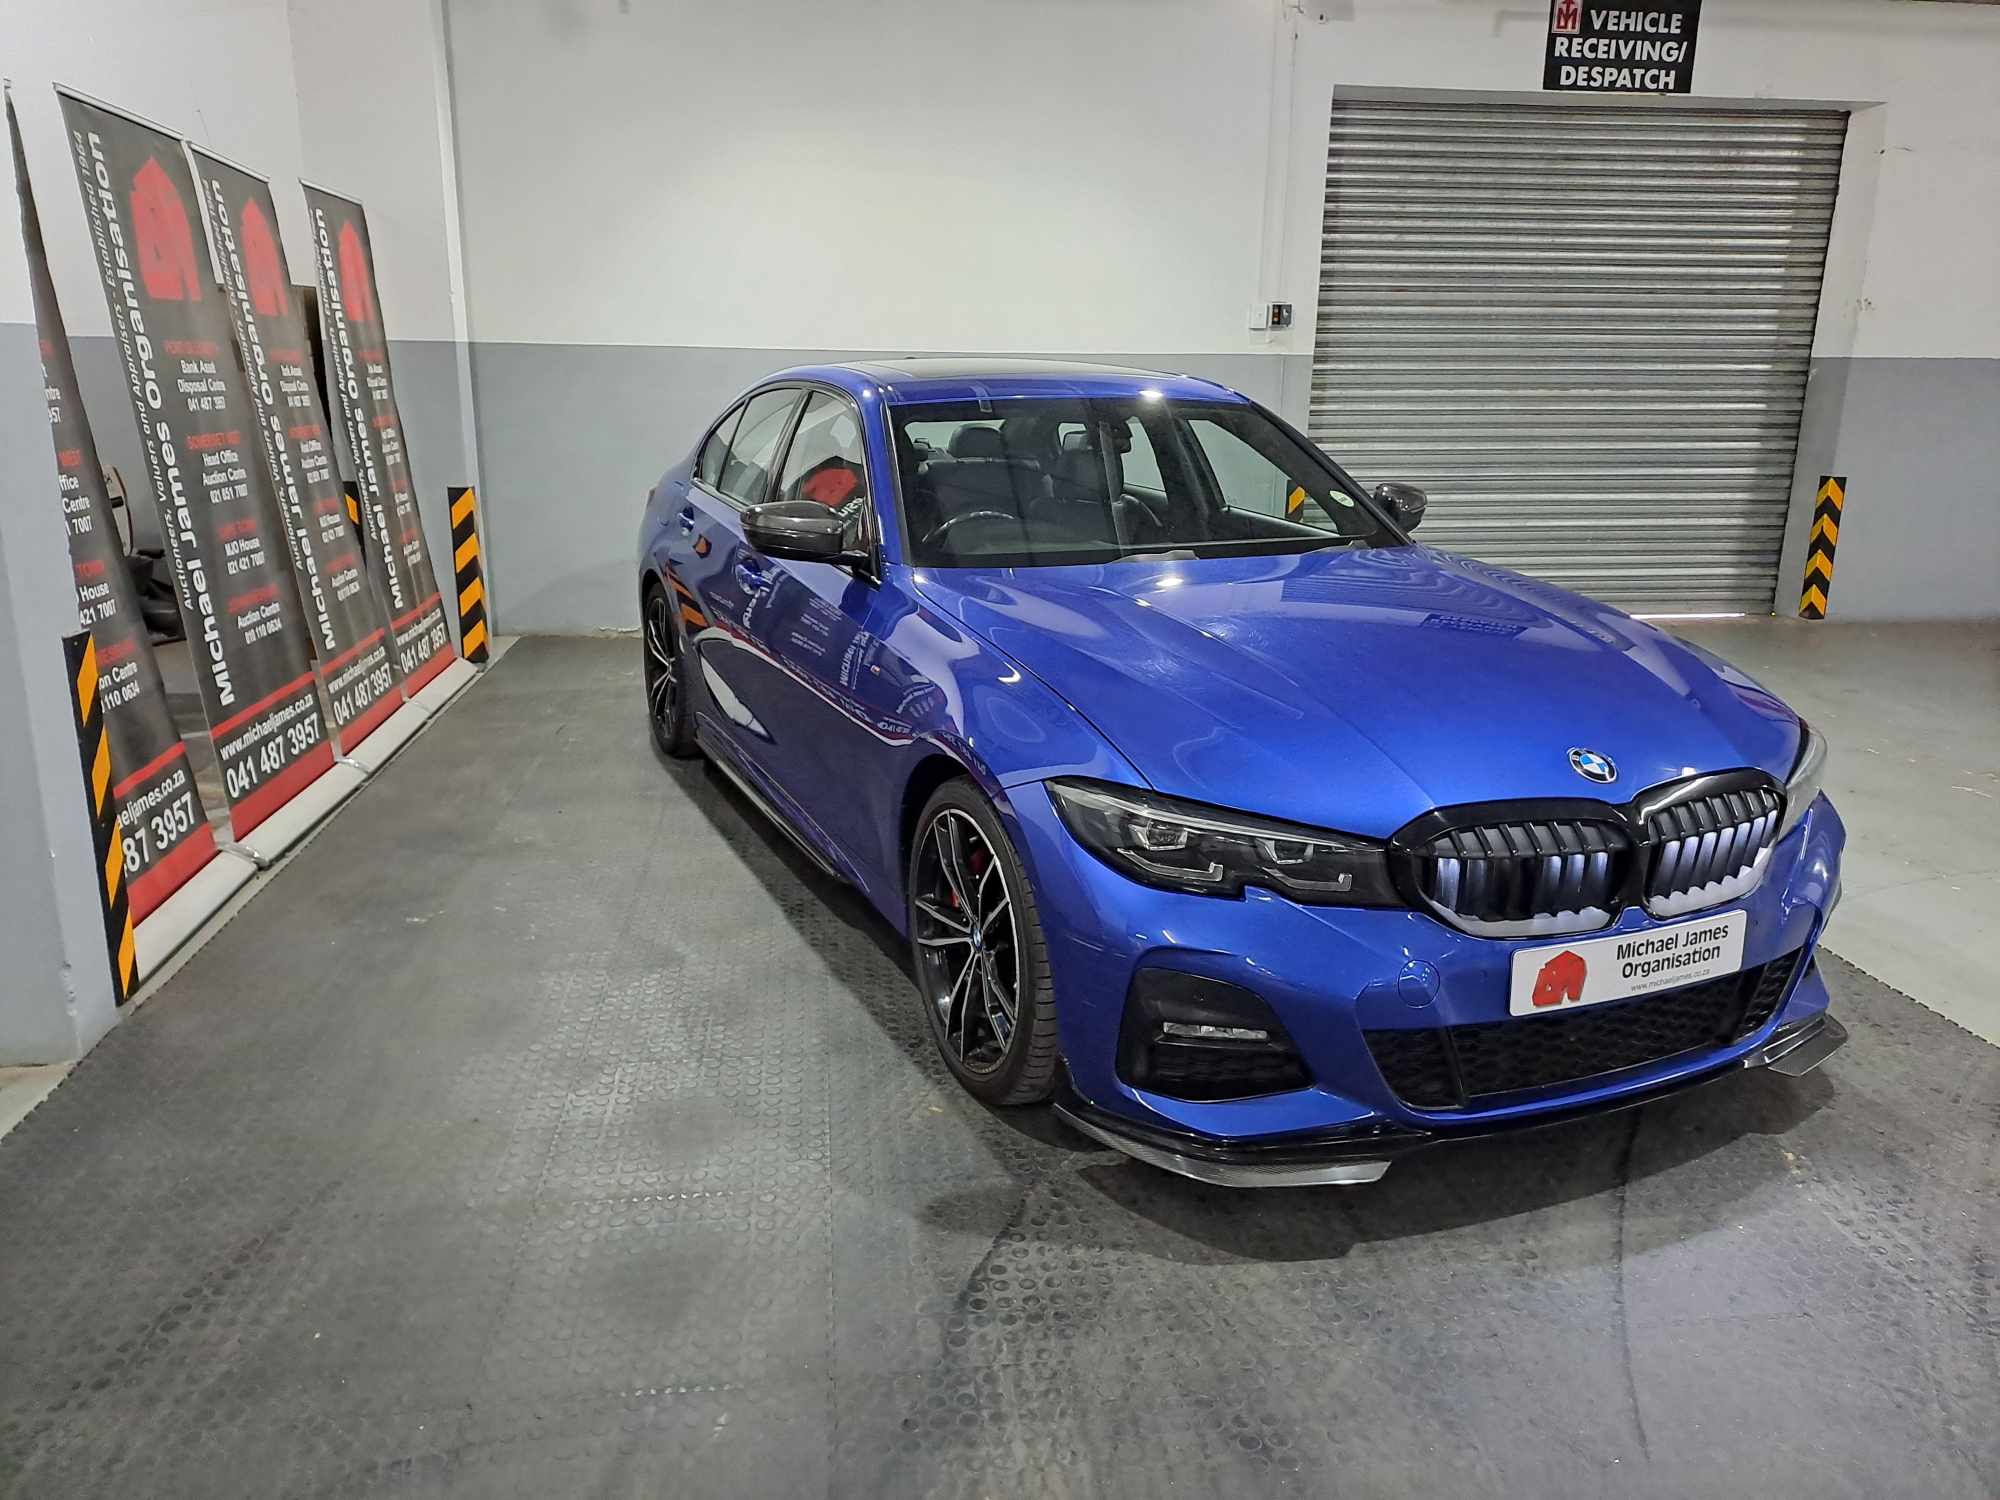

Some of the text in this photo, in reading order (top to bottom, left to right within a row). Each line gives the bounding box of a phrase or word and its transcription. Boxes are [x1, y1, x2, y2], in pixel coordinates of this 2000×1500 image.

[1554, 37, 1688, 63] RECEIVING/
[1590, 9, 1683, 34] VEHICLE
[1560, 65, 1676, 90] DESPATCH
[84, 181, 116, 287] Established
[211, 179, 273, 405] Organisation
[315, 208, 359, 400] Organisation
[113, 303, 142, 397] Appraisers
[88, 132, 235, 707] Michael James Organisation
[135, 400, 151, 434] and
[254, 397, 268, 426] and
[58, 474, 80, 491] ffice
[147, 440, 167, 501] Valuers
[270, 415, 303, 519] James
[354, 407, 380, 497] James
[62, 496, 90, 514] Centre
[164, 509, 194, 611] Auctioneers,
[373, 504, 403, 609] Michael
[80, 582, 109, 602] House
[296, 528, 336, 650] Michael
[112, 661, 138, 683] Centre
[400, 645, 418, 673] 041
[104, 690, 122, 710] 110
[333, 662, 393, 726] 041 487 3957
[220, 693, 314, 761] www.michaeljames.co.za
[226, 712, 320, 798] 041 487 3957
[118, 769, 186, 829] aeljames.co.za
[122, 791, 195, 877] 87 3957
[1616, 925, 1729, 960] Michael James
[1622, 945, 1721, 978] Organisation
